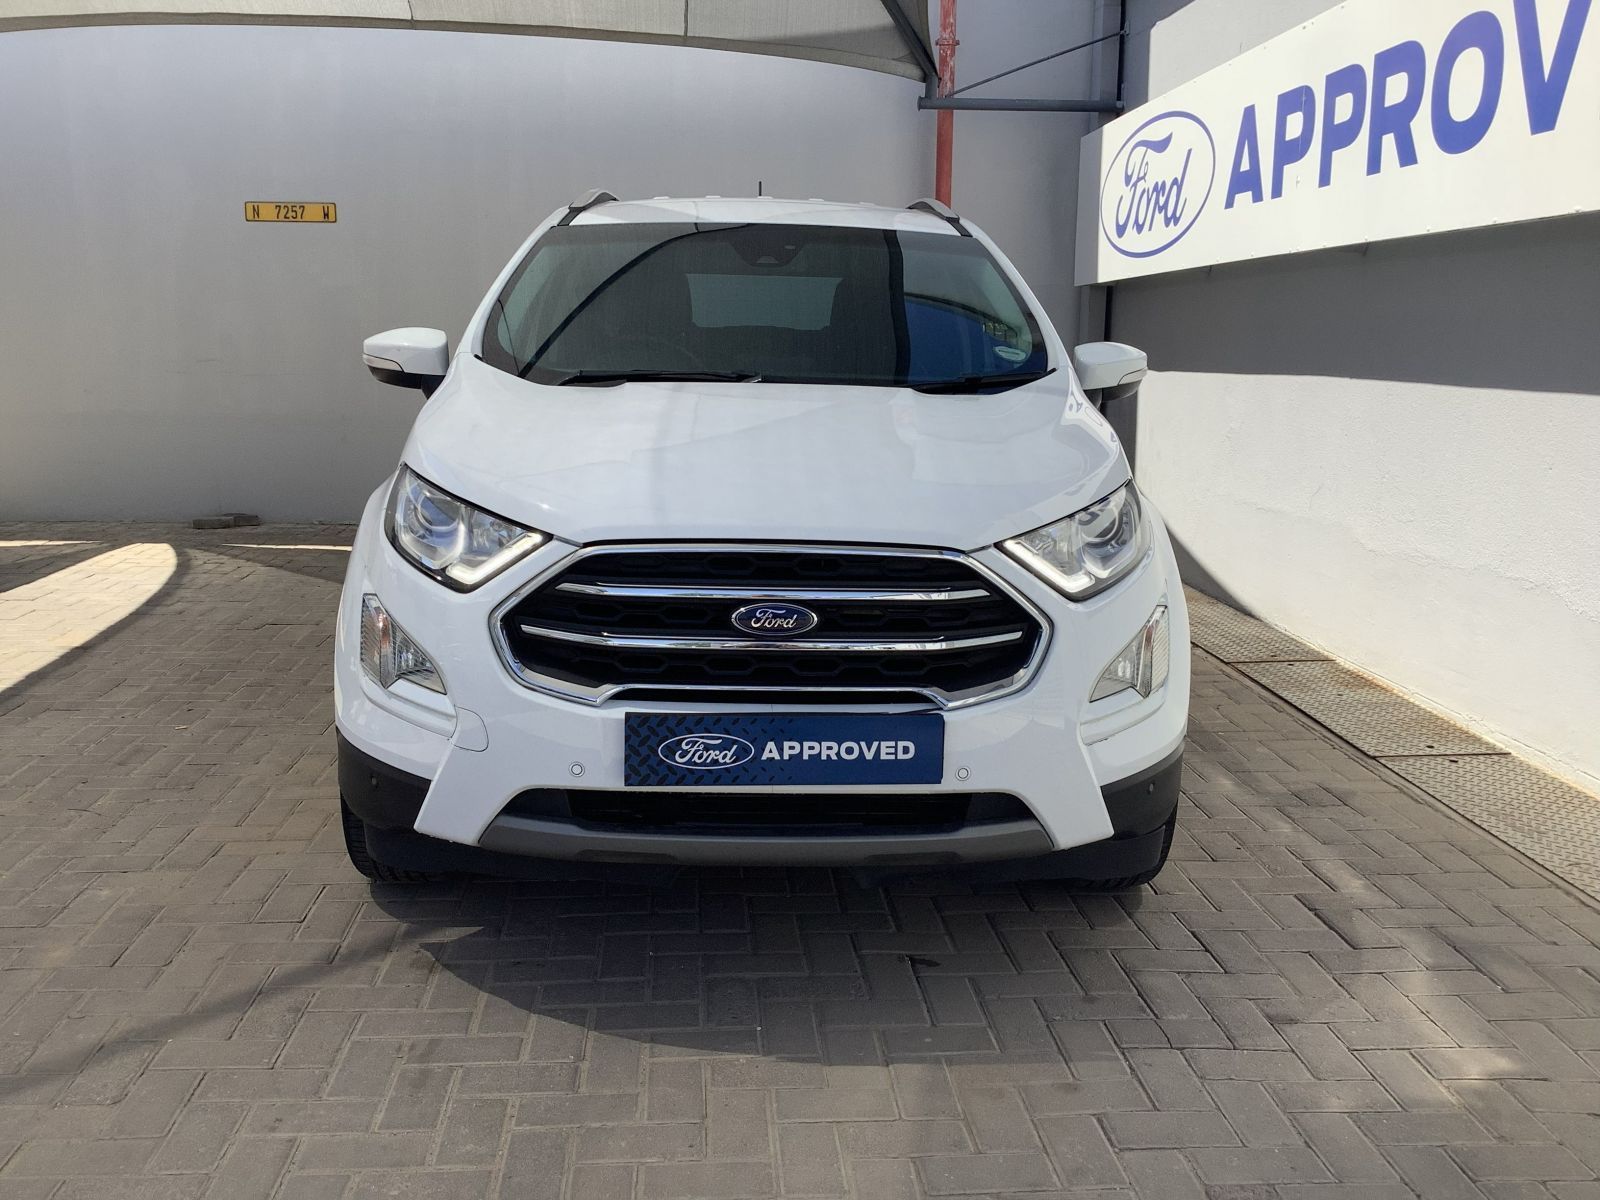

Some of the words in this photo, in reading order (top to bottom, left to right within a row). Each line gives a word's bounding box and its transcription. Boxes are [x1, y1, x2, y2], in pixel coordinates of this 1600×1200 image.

[1115, 133, 1193, 239] Ford
[252, 204, 260, 219] N
[274, 205, 305, 219] 7257
[322, 205, 330, 220] W
[751, 608, 798, 628] Ford
[675, 736, 737, 764] Ford
[761, 741, 916, 760] APPROVED
